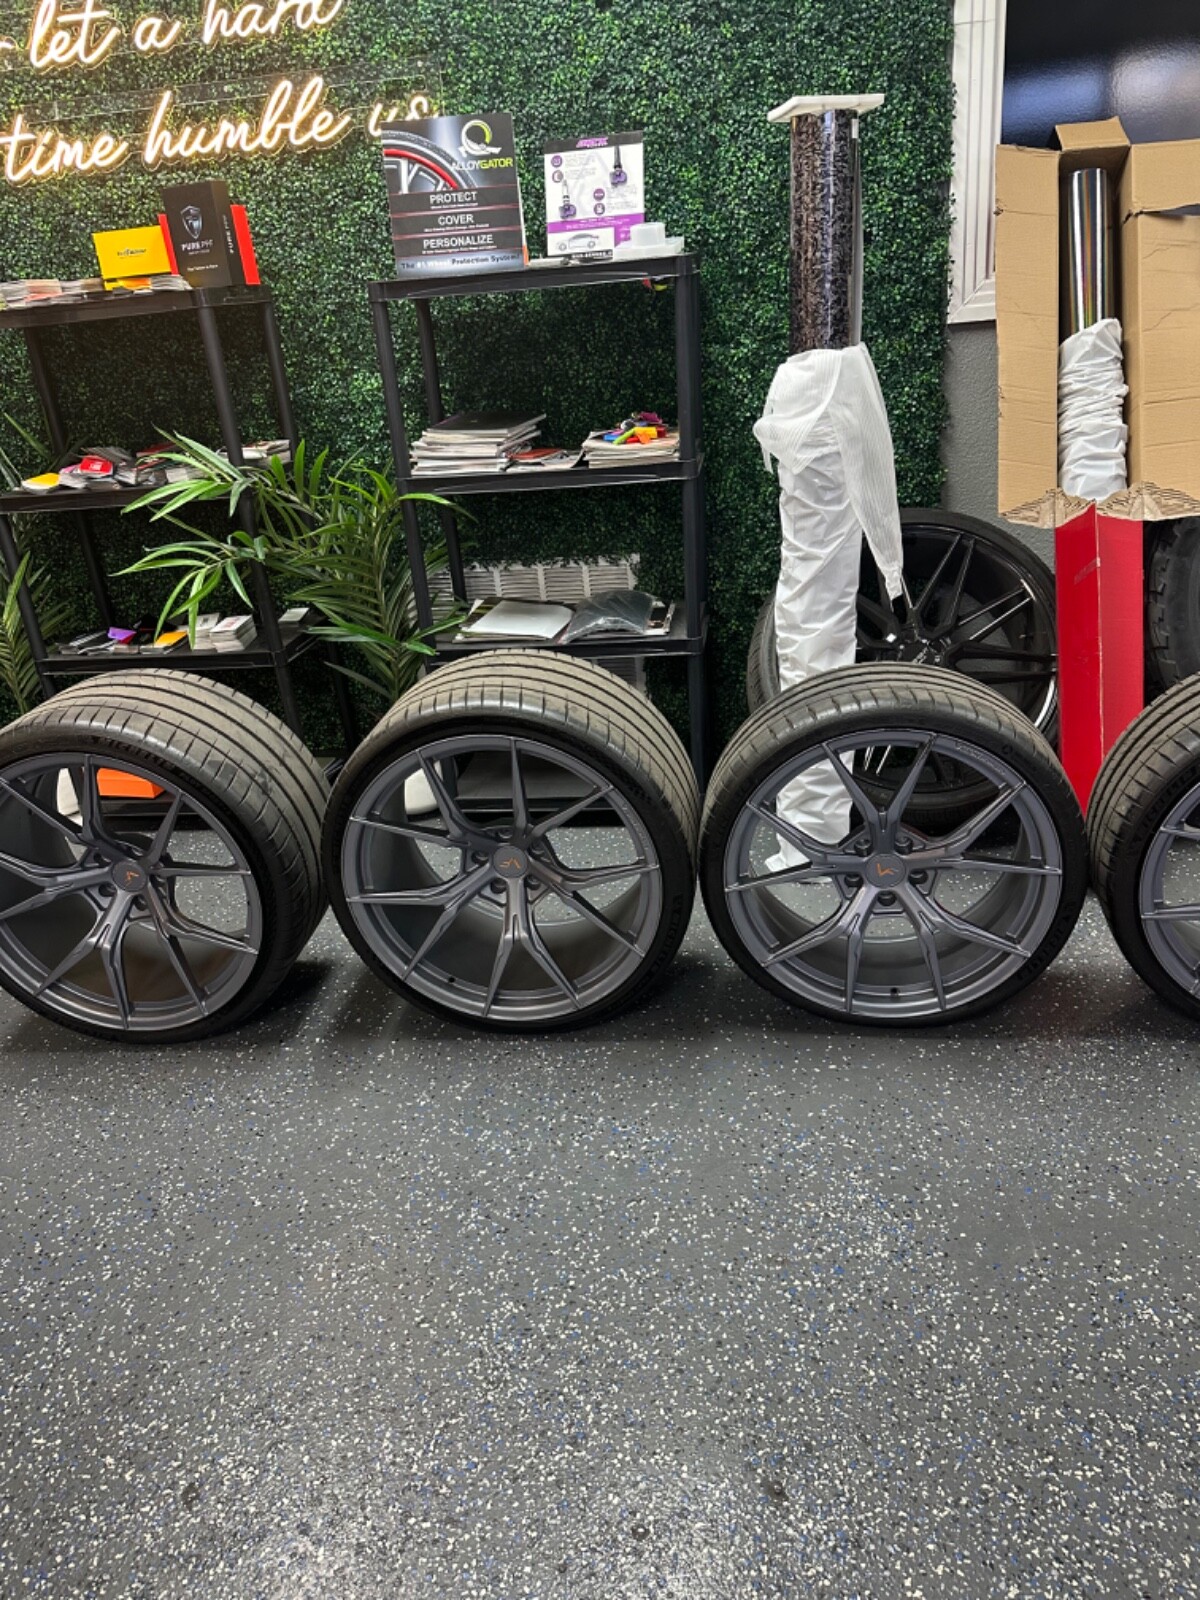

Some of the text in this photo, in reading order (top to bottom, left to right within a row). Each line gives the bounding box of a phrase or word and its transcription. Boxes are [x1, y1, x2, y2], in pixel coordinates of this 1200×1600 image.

[29, 0, 342, 67] let a hard
[0, 114, 129, 182] time
[145, 77, 351, 164] humble
[451, 157, 514, 171] ALLOYGATOR
[430, 191, 478, 204] PROTECT
[437, 213, 475, 226] COVER
[181, 241, 201, 251] PURE
[423, 234, 494, 249] PERSONALIZE
[451, 256, 489, 265] Protection
